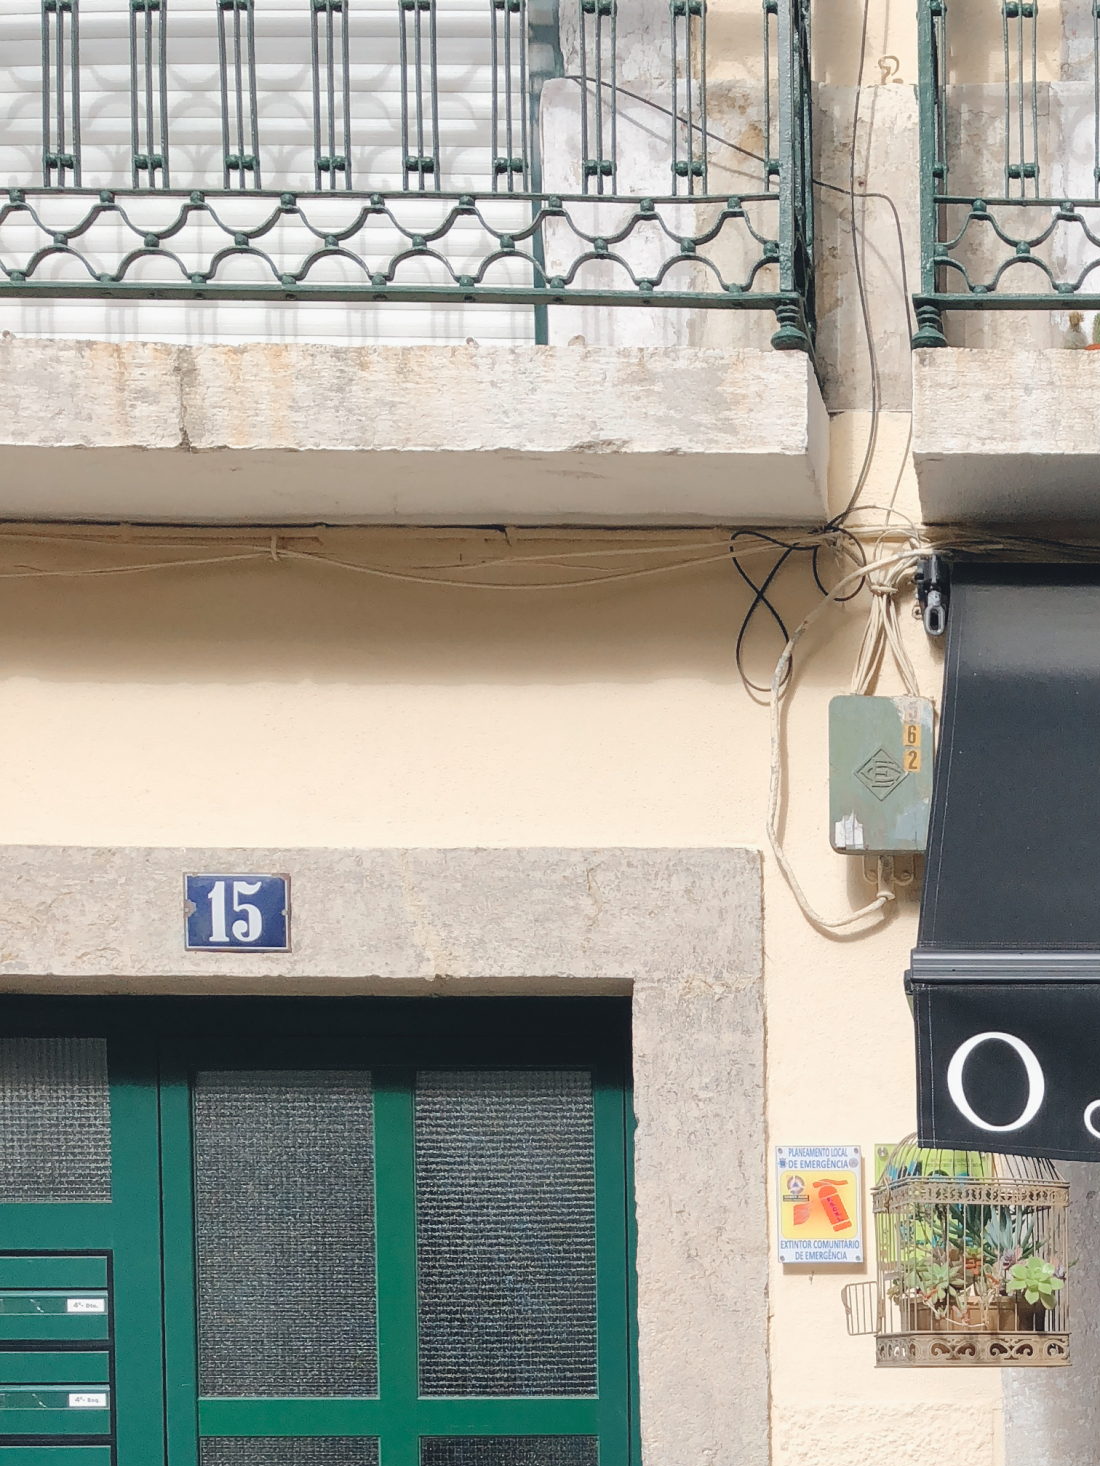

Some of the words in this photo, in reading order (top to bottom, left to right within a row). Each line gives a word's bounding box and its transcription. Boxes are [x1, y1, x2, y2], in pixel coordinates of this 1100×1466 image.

[207, 880, 263, 943] 15
[946, 1031, 1045, 1132] O
[788, 1147, 830, 1158] PLANEAMENTO
[831, 1147, 849, 1158] LOCAL
[788, 1159, 799, 1169] DE
[800, 1157, 849, 1169] EMERGÊNCIA
[780, 1239, 812, 1250] EXTINTOR
[794, 1251, 804, 1261] DE
[805, 1248, 848, 1261] EMERGÊNCIA
